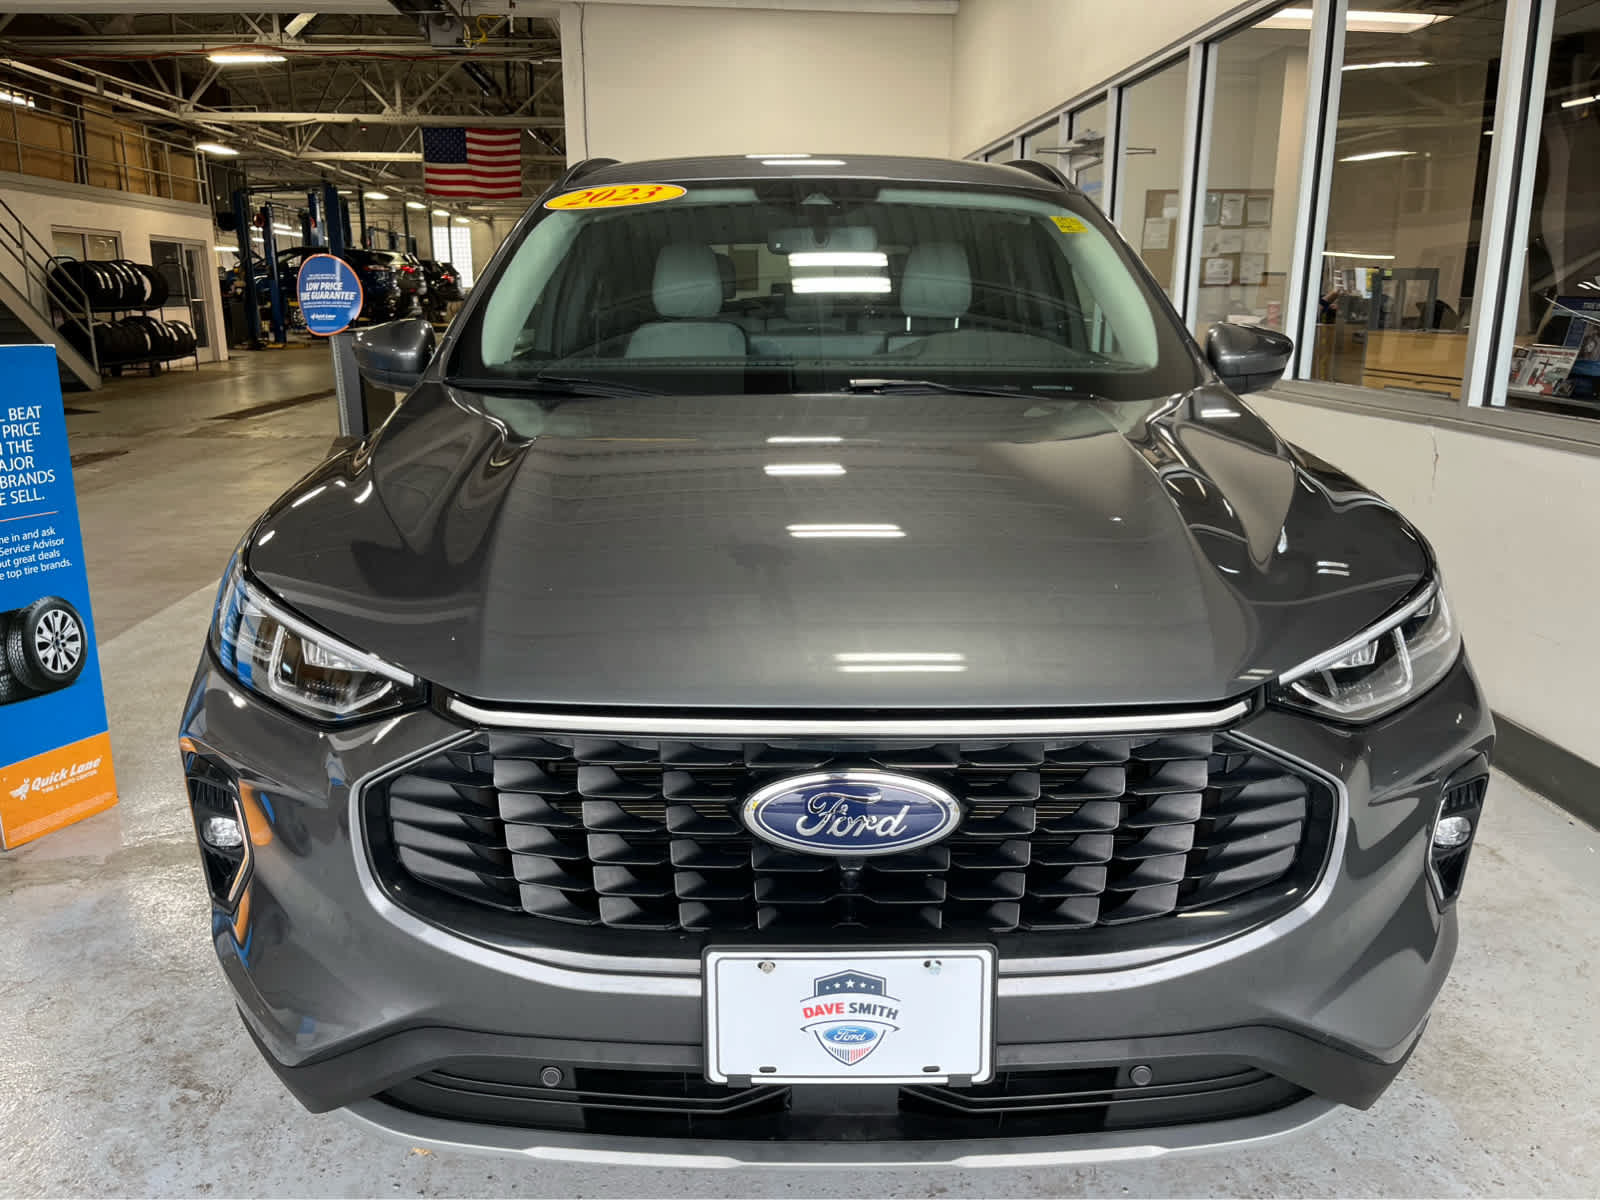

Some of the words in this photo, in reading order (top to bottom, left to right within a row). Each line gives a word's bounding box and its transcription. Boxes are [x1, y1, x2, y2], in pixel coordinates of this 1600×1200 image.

[563, 186, 665, 206] 2023
[306, 282, 320, 291] LOW
[320, 281, 343, 291] PRICE
[311, 291, 357, 300] GUARANTEE
[8, 405, 42, 421] BEAT
[2, 422, 41, 438] PRICE
[6, 439, 34, 455] THE
[0, 469, 56, 489] BRANDS
[10, 488, 46, 504] SELL.
[12, 533, 20, 542] in
[22, 528, 39, 540] and
[41, 526, 56, 537] ask
[33, 537, 64, 549] Advisor
[13, 554, 36, 568] great
[38, 549, 60, 560] deals
[6, 569, 22, 579] top
[24, 566, 39, 575] tire
[40, 558, 72, 571] brands.
[31, 767, 69, 791] Quick
[69, 757, 102, 777] Lane
[796, 791, 911, 838] Ford
[802, 1002, 845, 1019] DAVE
[848, 1002, 899, 1020] SMITH
[833, 1026, 866, 1041] Ford
